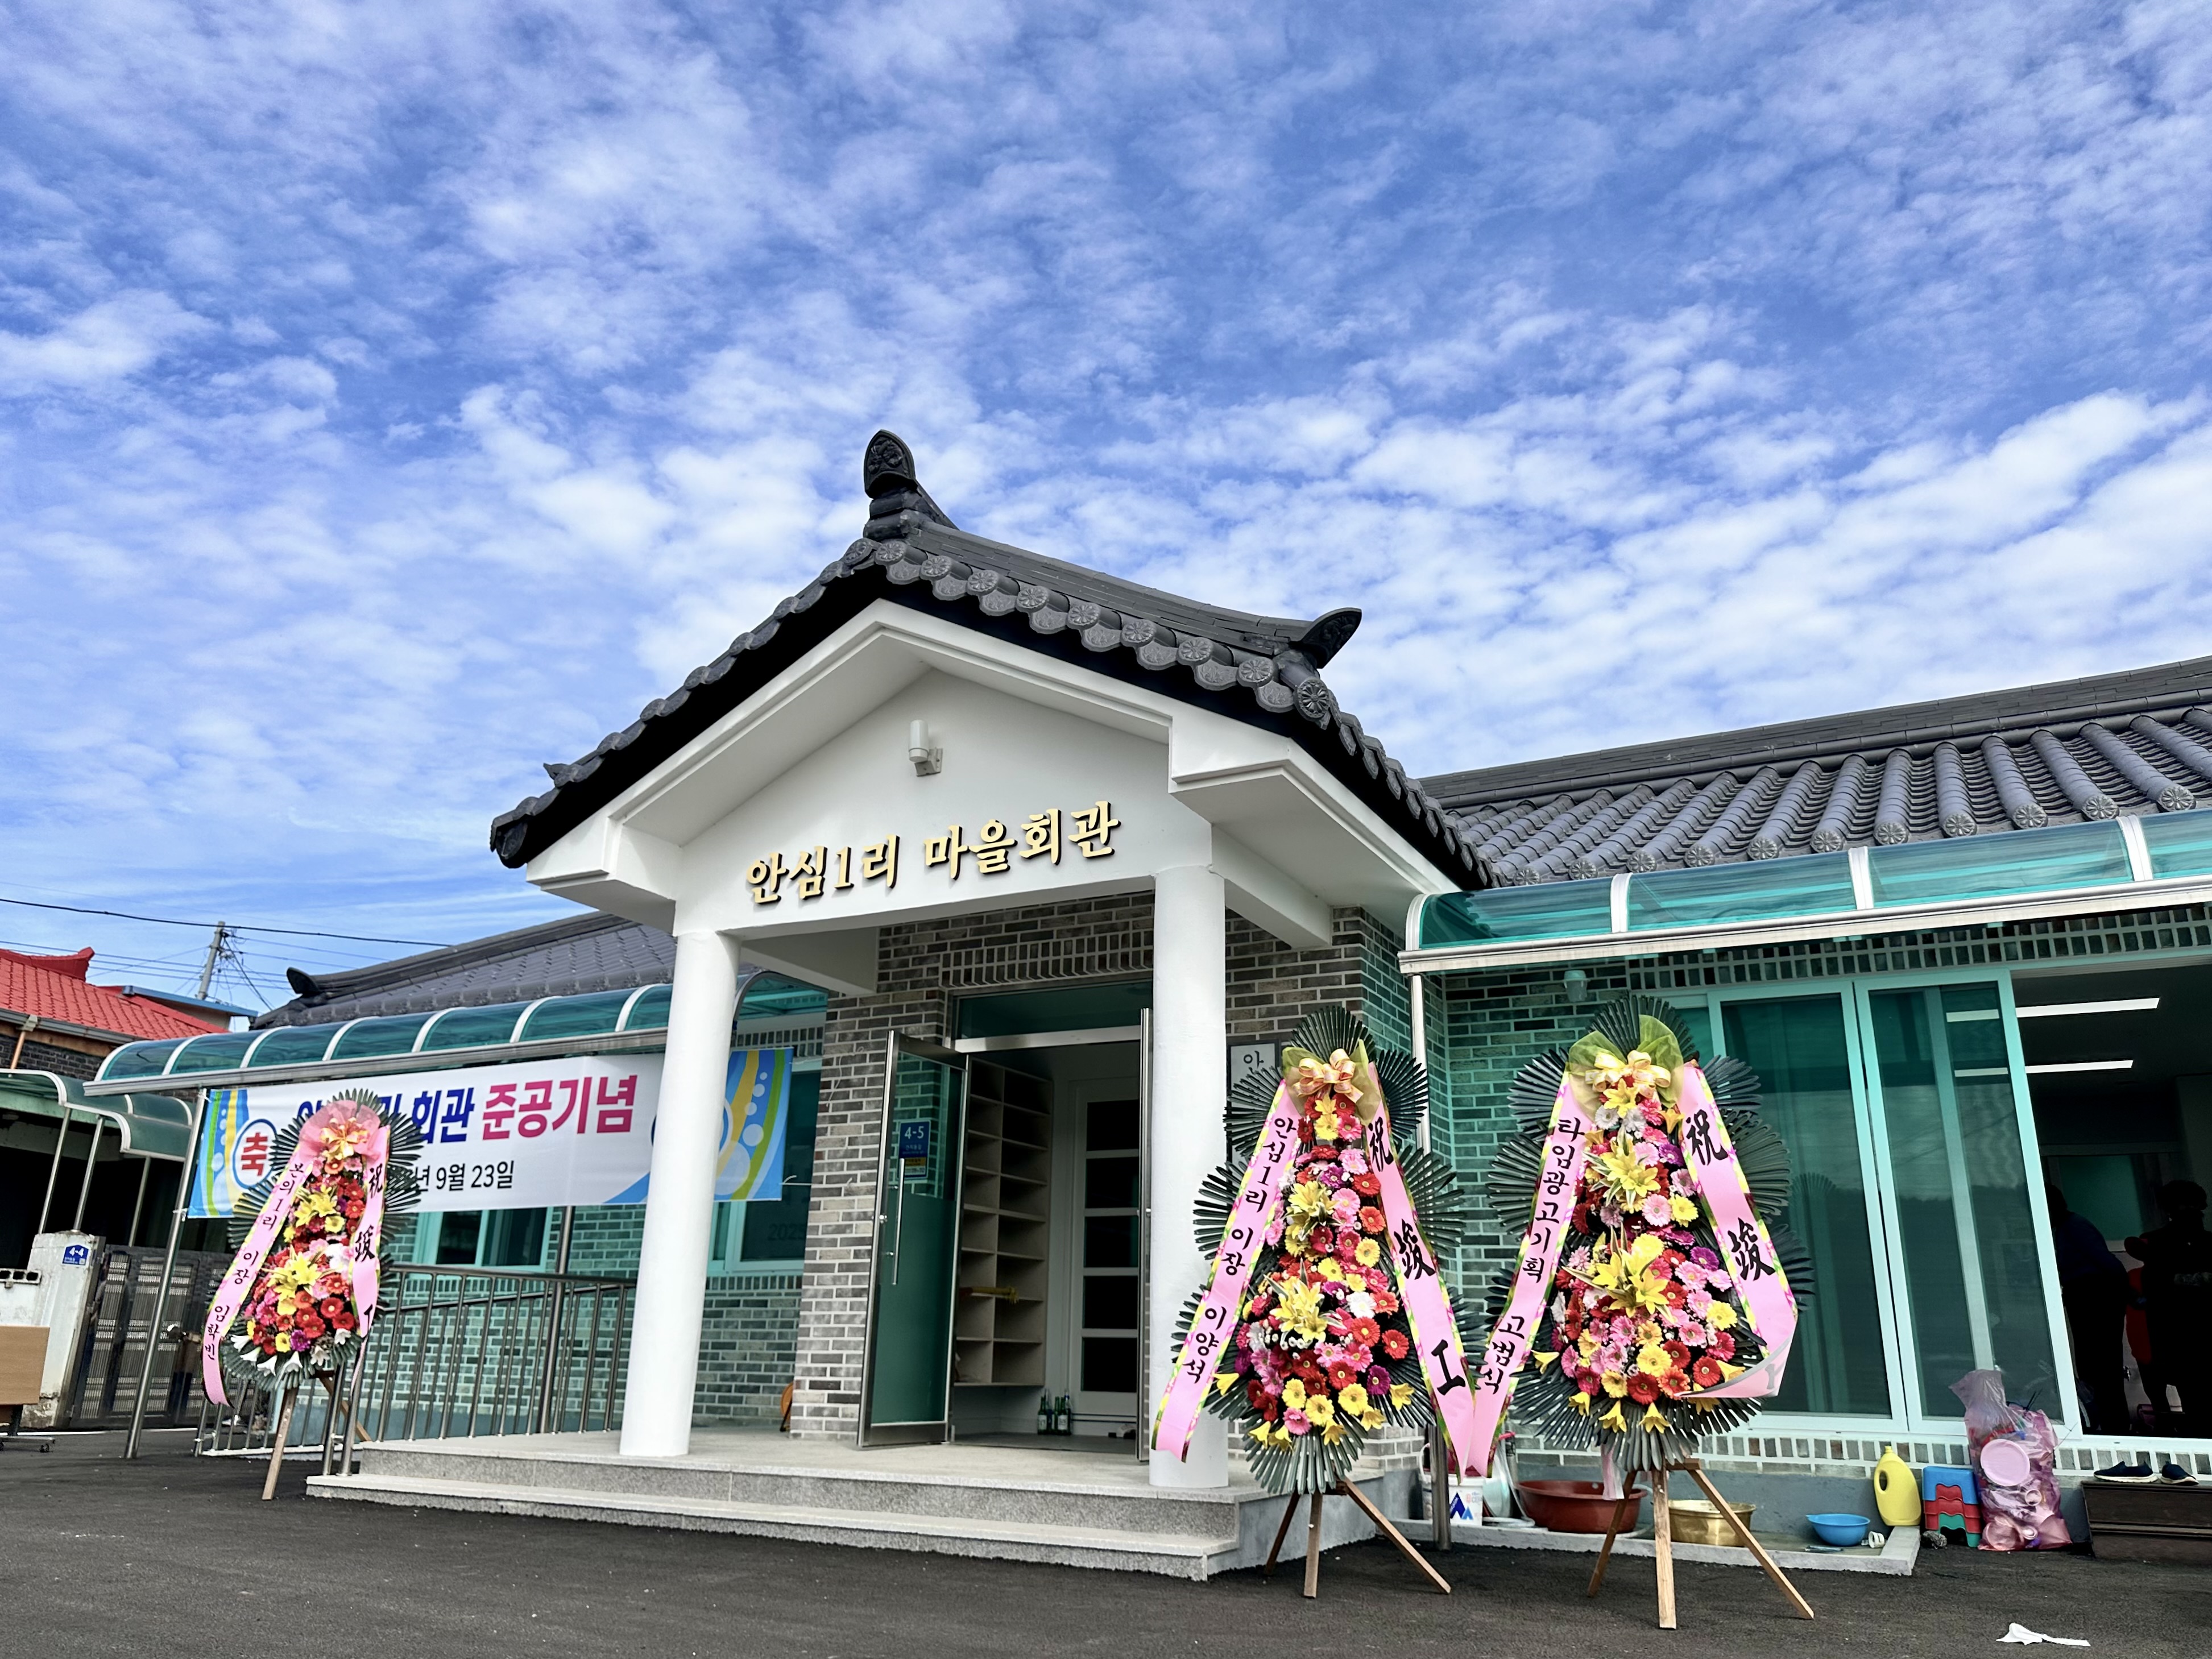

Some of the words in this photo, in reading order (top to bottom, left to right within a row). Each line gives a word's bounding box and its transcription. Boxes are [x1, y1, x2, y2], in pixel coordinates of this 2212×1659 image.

[746, 834, 900, 904] 안심1리
[923, 801, 1121, 880] 마을회관
[412, 1088, 475, 1144] 회관
[482, 1075, 637, 1140] 준공기념
[904, 1126, 925, 1139] 4-5
[241, 1132, 268, 1176] 축
[436, 1163, 466, 1192] 9월
[471, 1160, 515, 1190] 23일
[1245, 1117, 1297, 1213] 안심1리
[1522, 1117, 1586, 1283] 타임광고기획
[69, 1247, 84, 1258] 4-4
[234, 1250, 259, 1285] 이장
[1221, 1226, 1254, 1276] 이장
[1182, 1306, 1227, 1384] 이양석
[1483, 1315, 1525, 1395] 고범식
